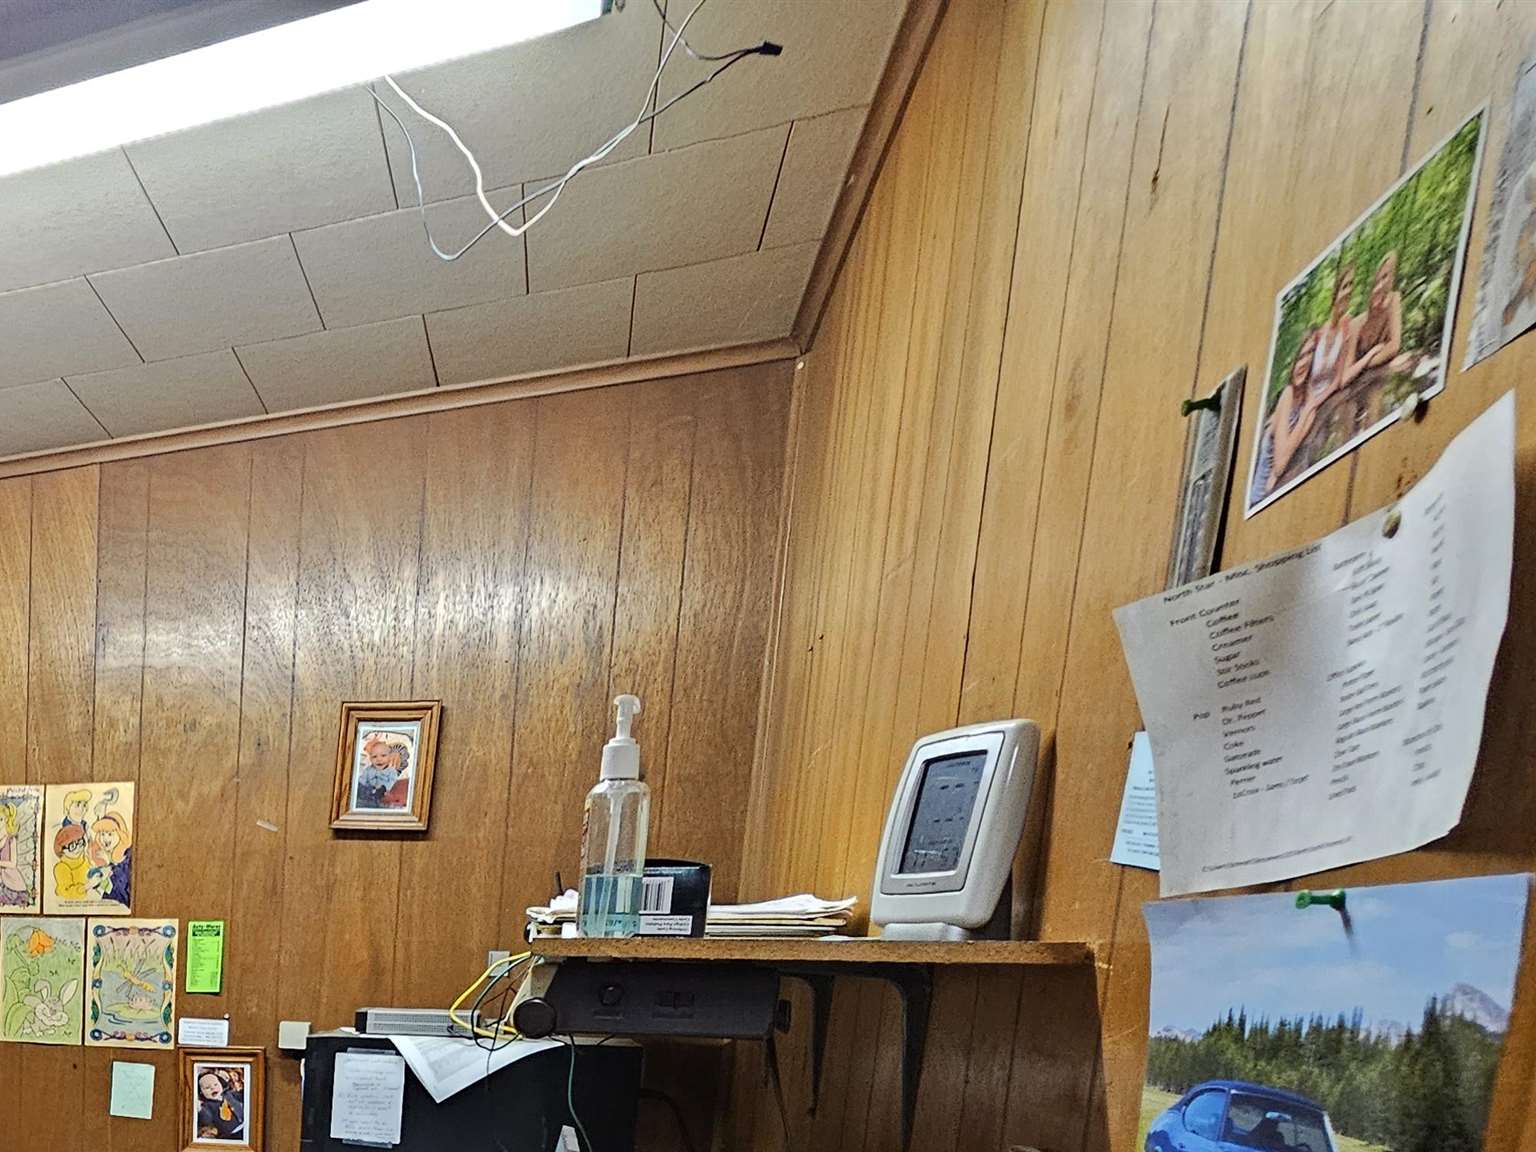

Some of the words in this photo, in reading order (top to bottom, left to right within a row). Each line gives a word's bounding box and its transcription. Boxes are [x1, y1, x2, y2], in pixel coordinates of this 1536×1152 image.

[1163, 589, 1192, 603] North
[1195, 581, 1215, 592] Star
[1254, 550, 1304, 571] Shopping
[1170, 613, 1196, 627] Front
[1199, 599, 1240, 617] Counter
[1206, 612, 1239, 628] Coffee
[1209, 625, 1241, 640] Coffee
[1244, 615, 1275, 628] Filters
[1211, 635, 1253, 651] Creamer
[1214, 651, 1240, 665] Sugar
[1217, 675, 1247, 689] Coffee
[1237, 709, 1266, 721] Pepper
[1224, 741, 1244, 750] Coke
